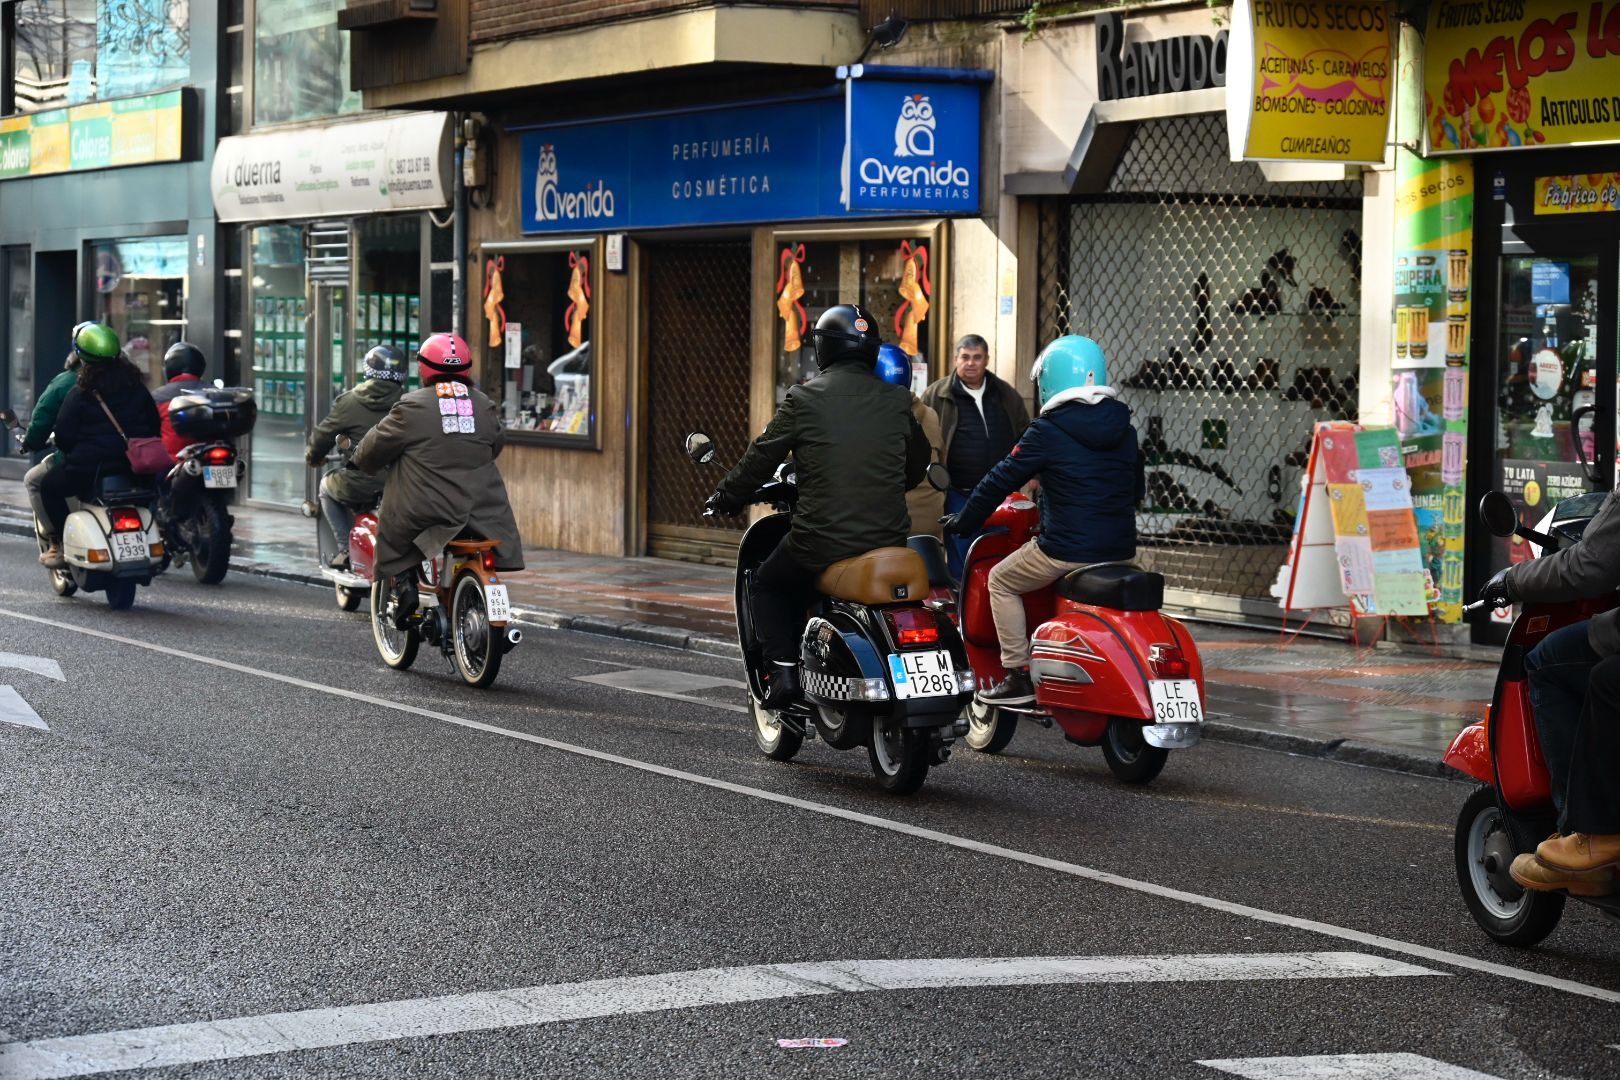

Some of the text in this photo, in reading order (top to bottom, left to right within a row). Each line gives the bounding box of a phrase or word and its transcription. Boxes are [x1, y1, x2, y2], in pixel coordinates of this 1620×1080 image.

[1255, 1, 1385, 32] FRUTOS SECOS
[1260, 57, 1387, 78] ACEITUNAS CARAMELOS
[1255, 96, 1386, 116] BOMBONES GOLOSINAS
[1541, 96, 1611, 127] ARTICULOS
[72, 125, 110, 161] Colores
[672, 133, 770, 160] PERFUMERÍA
[1280, 136, 1351, 154] CUMPLEAÑOS
[672, 174, 770, 199] COSMÉTICA
[860, 186, 970, 199] PERFUMERÍAS
[1419, 175, 1465, 198] secos
[1600, 182, 1617, 203] de
[1503, 467, 1536, 480] TU LATA
[118, 545, 146, 559] 2939
[903, 654, 949, 674] LE M
[910, 674, 953, 694] 1286
[1163, 682, 1184, 699] LE
[1156, 701, 1199, 719] 36178
